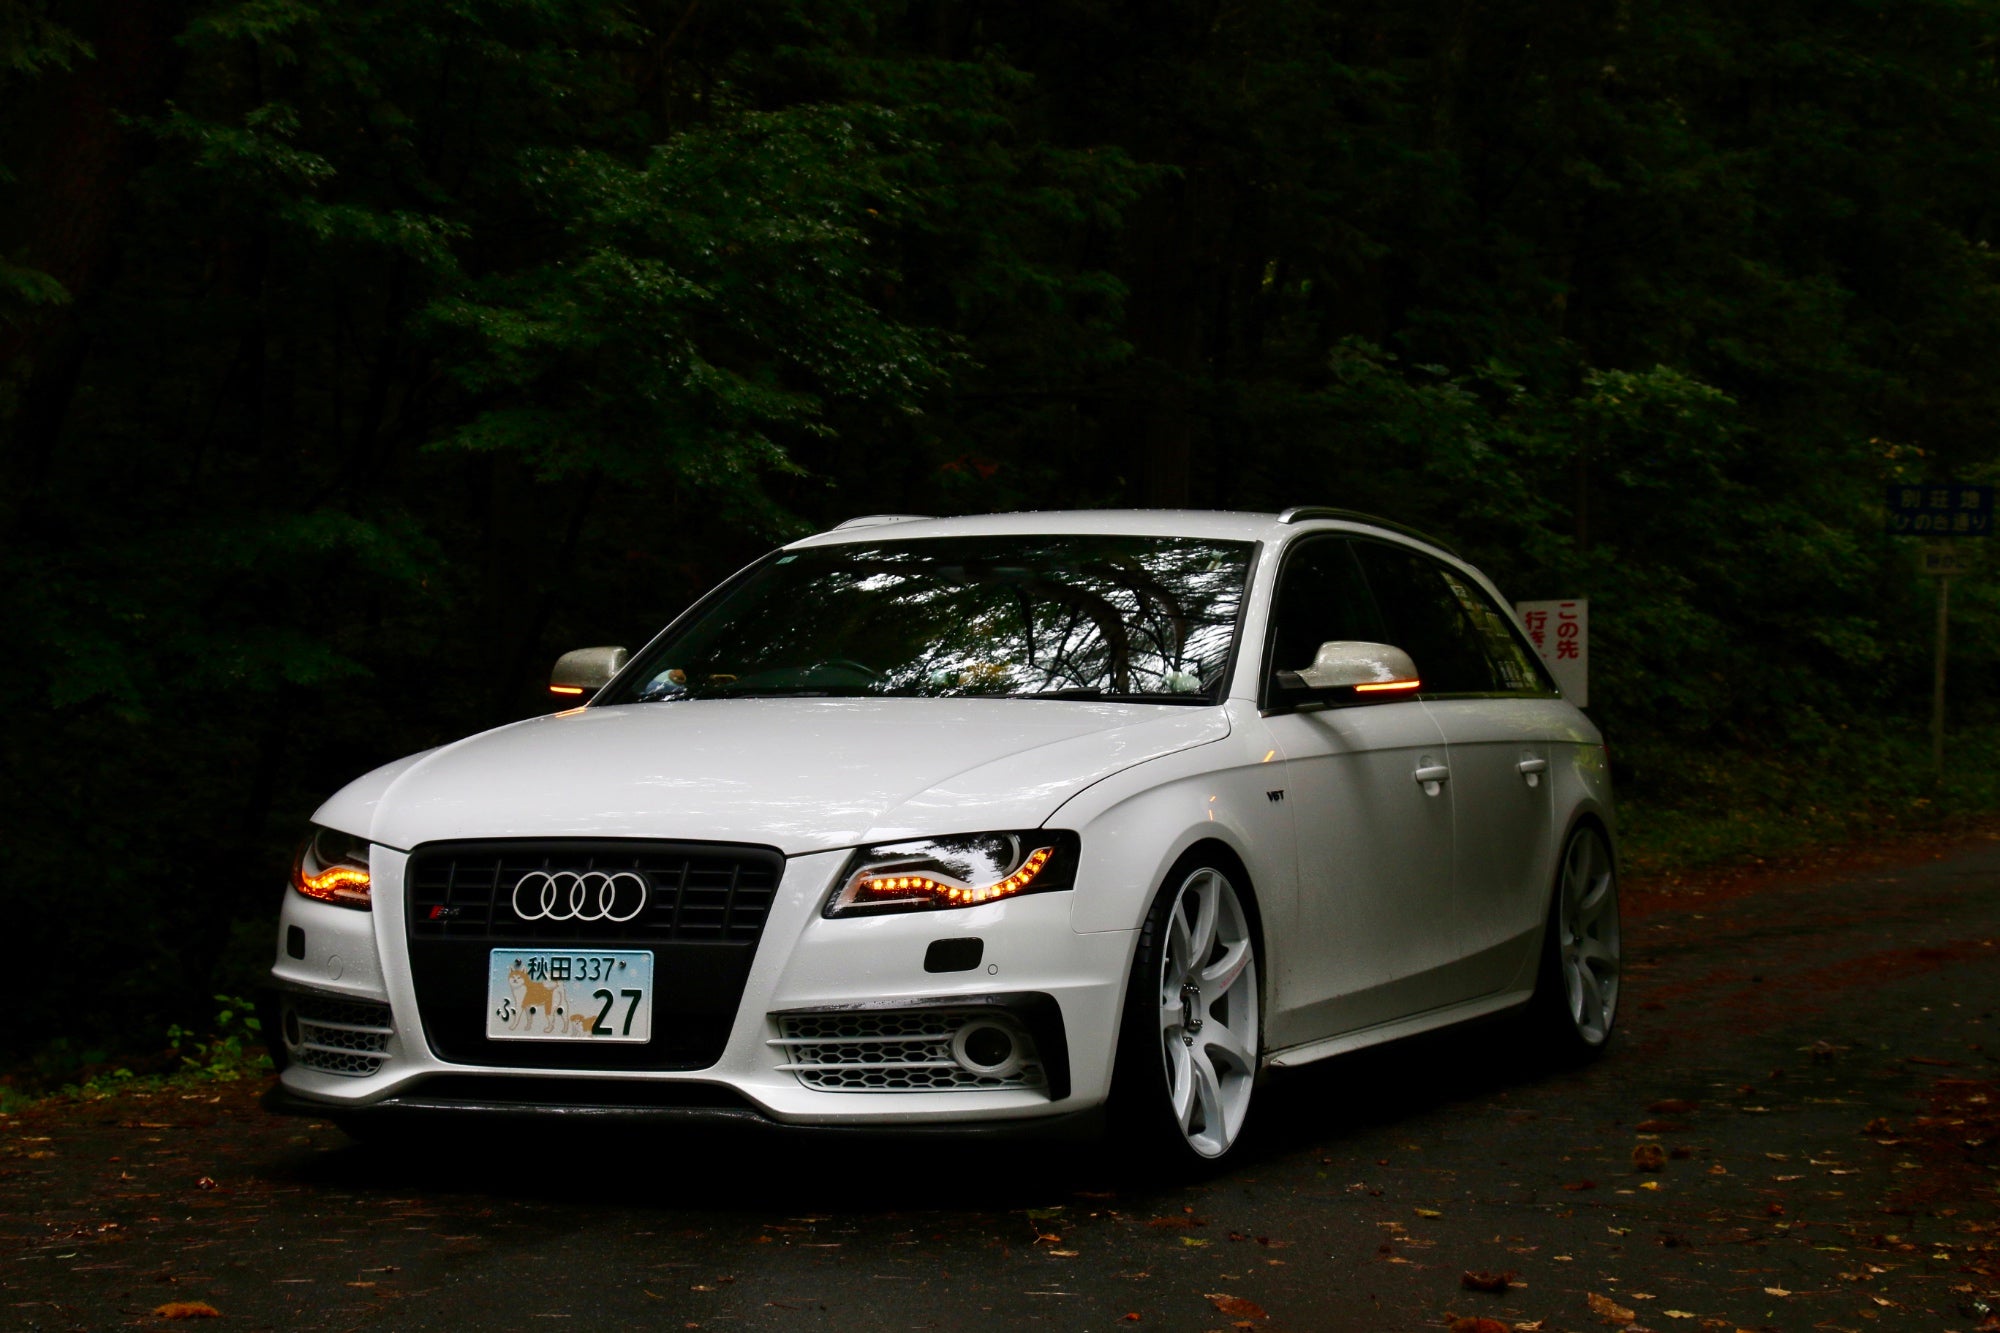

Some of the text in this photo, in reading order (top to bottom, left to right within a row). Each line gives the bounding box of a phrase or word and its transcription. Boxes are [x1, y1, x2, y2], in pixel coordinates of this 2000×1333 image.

[1525, 611, 1548, 658] 行き
[1557, 603, 1579, 659] この先
[496, 988, 643, 1036] ふ 27
